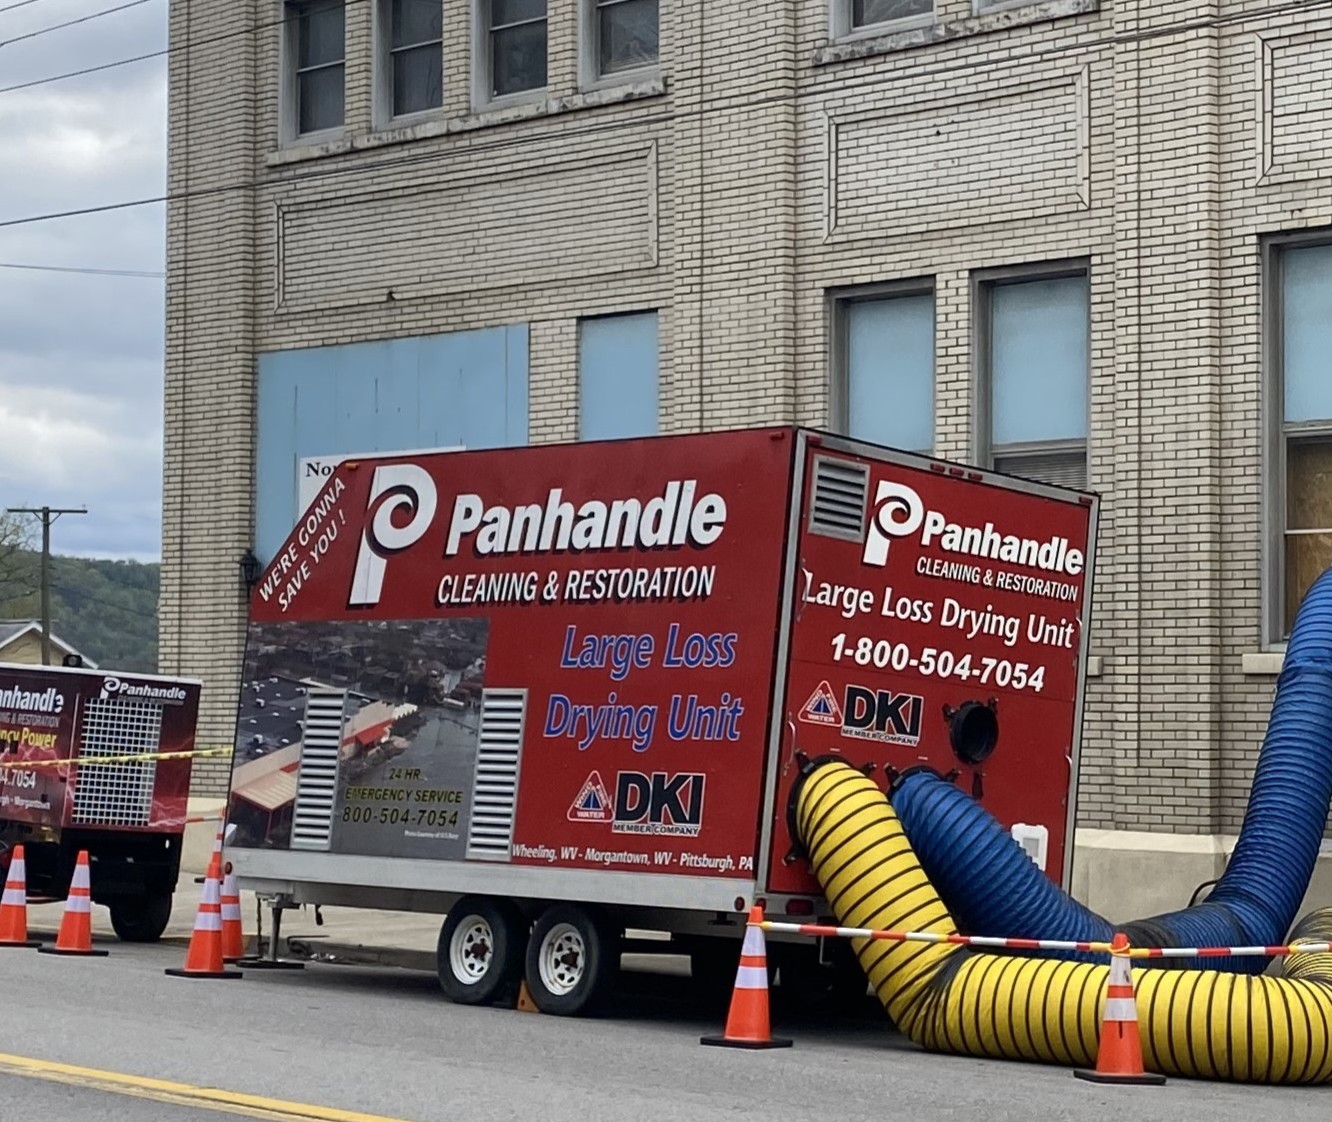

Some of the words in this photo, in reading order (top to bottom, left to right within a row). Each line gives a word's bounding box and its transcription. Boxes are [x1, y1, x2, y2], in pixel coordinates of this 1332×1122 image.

[305, 461, 337, 477] No
[445, 479, 727, 556] Panhandle
[259, 543, 299, 602] WE'RE
[298, 477, 346, 547] GONNA
[920, 510, 1084, 576] Panhandle
[278, 561, 311, 612] SAVE
[310, 520, 337, 565] YOU
[438, 571, 538, 604] CLEANING
[543, 571, 559, 600] &
[564, 565, 716, 600] RESTORATION
[916, 556, 980, 584] CLEANING
[982, 569, 993, 586] &
[995, 571, 1079, 602] RESTORATION
[802, 571, 874, 618] Large
[881, 587, 933, 623] Loss
[940, 598, 1020, 647] Drying
[1027, 614, 1074, 649] Unit
[560, 624, 655, 681] Large
[662, 623, 738, 668] Loss
[831, 633, 1046, 693] 1-800-504-7054
[119, 682, 187, 700] Panhandle
[843, 684, 924, 738] DKI
[21, 727, 57, 748] Power
[543, 692, 658, 752] Drying
[667, 692, 744, 741] Unit
[842, 728, 878, 739] MEMBER
[879, 733, 918, 746] COMPANY
[345, 787, 412, 801] EMERGENCY
[414, 789, 463, 803] SERVICE
[389, 768, 402, 780] 24
[404, 768, 421, 780] HR
[342, 806, 459, 828] 800-504-7054
[576, 811, 605, 819] WATER
[614, 770, 706, 825] DKI
[613, 824, 651, 833] MEMBER
[654, 825, 699, 836] COMPANY
[512, 843, 557, 862] Wheeling,
[560, 847, 578, 860] WV
[584, 848, 651, 866] Morgantown,
[653, 851, 672, 866] WV
[679, 853, 736, 872] Pittsburgh,
[738, 856, 753, 870] PA
